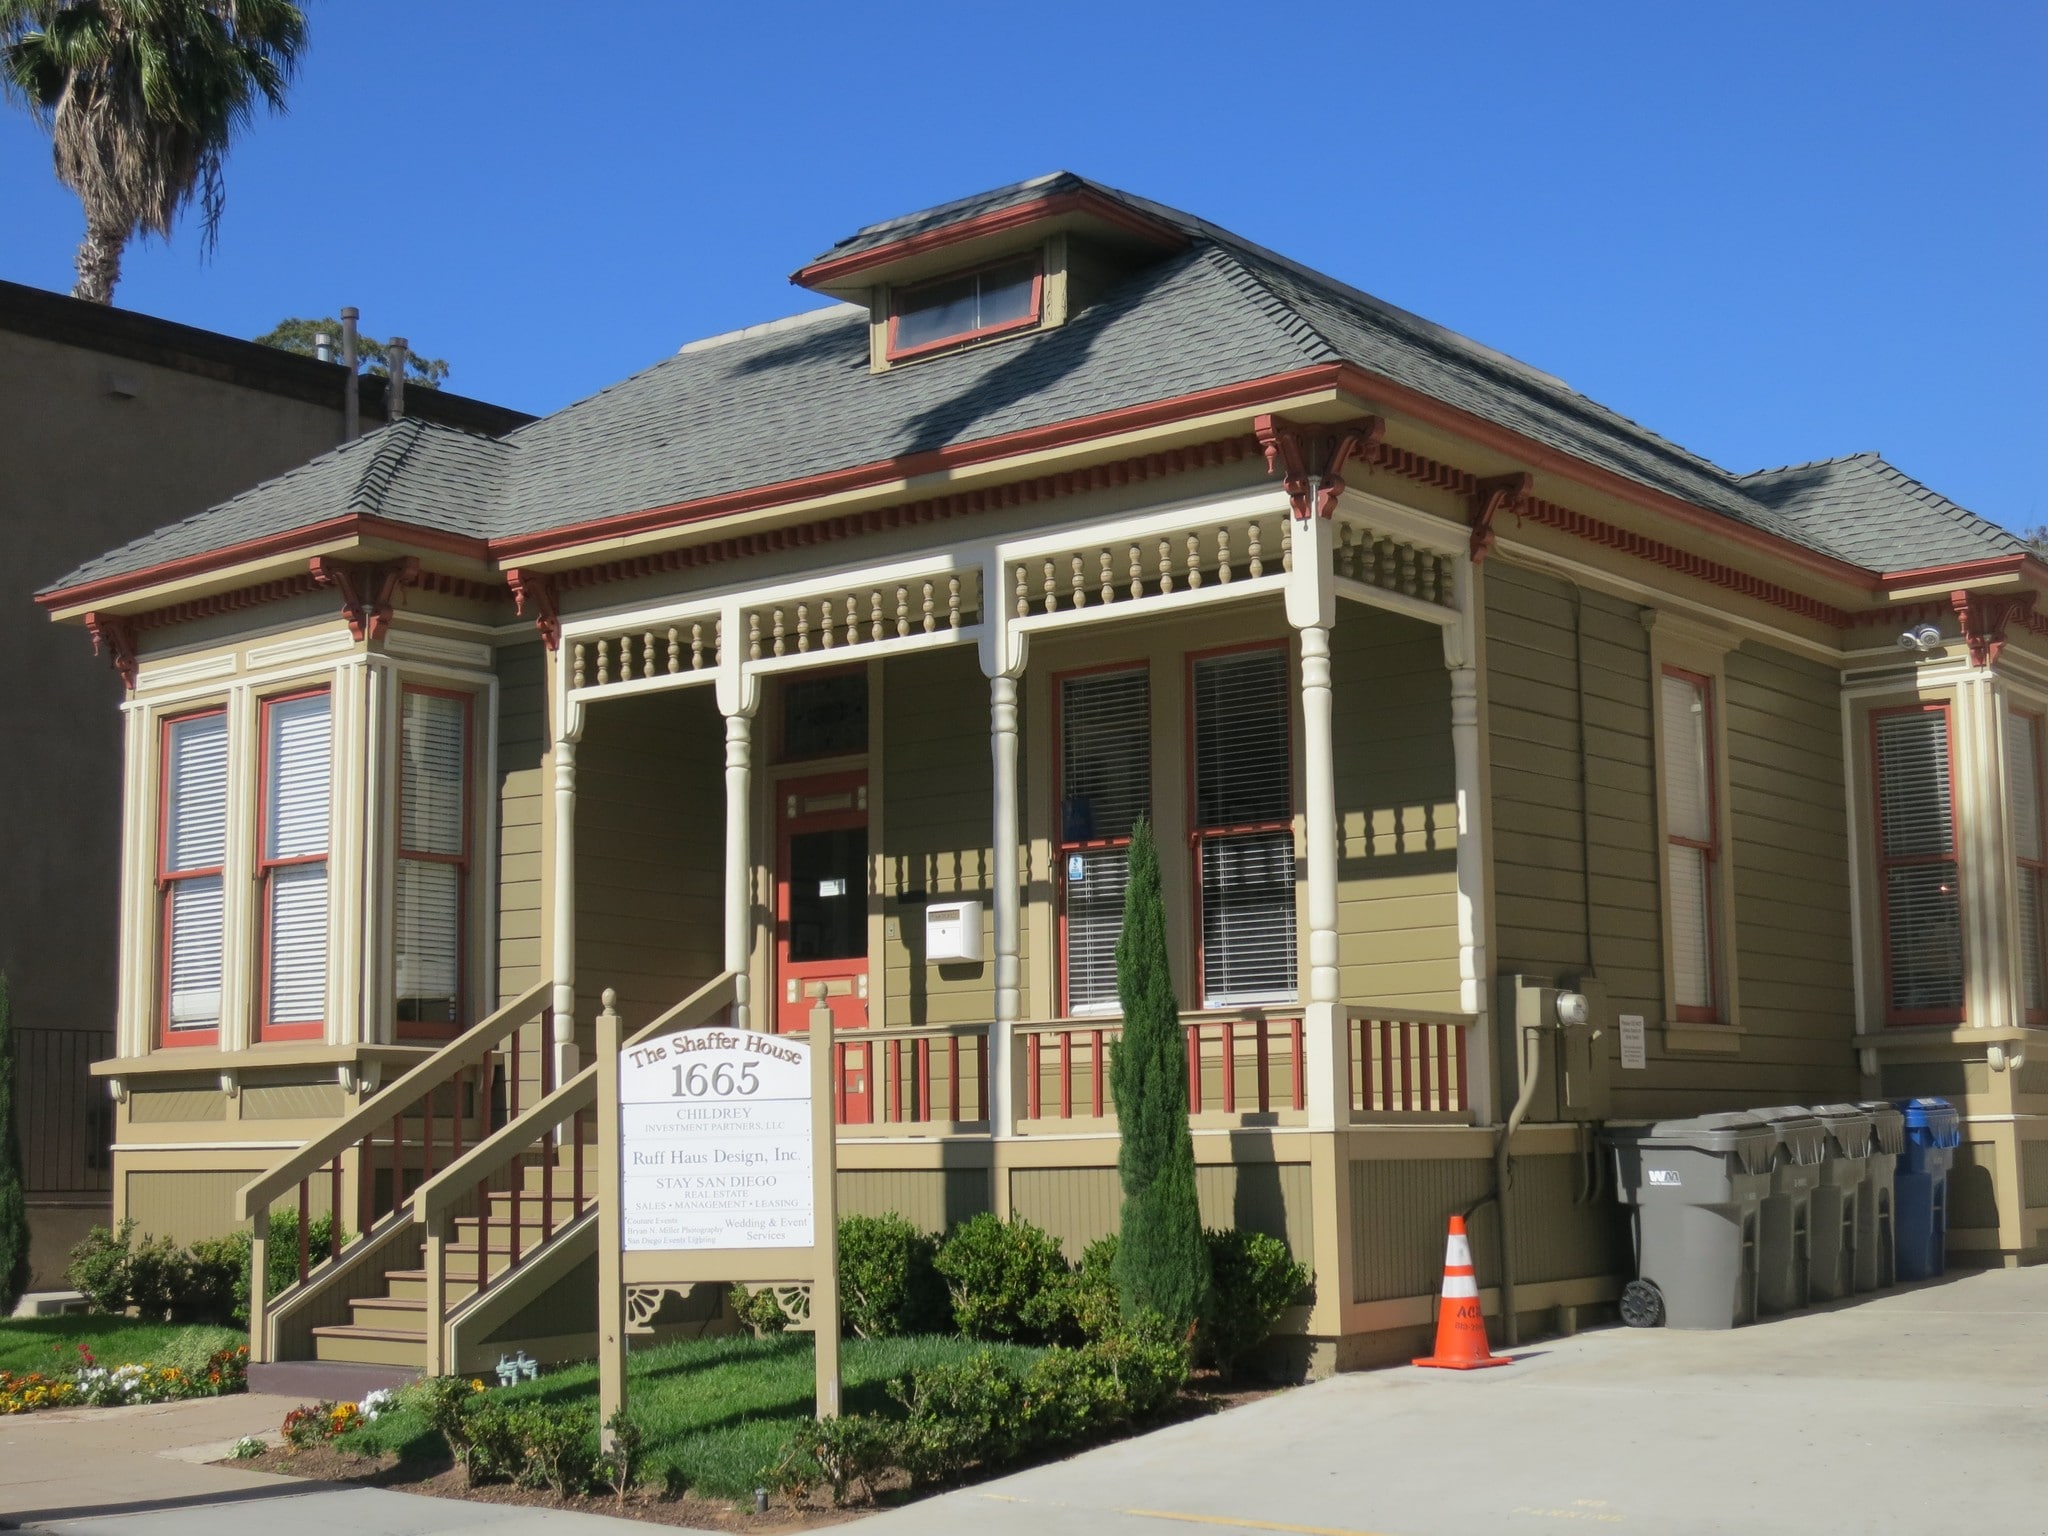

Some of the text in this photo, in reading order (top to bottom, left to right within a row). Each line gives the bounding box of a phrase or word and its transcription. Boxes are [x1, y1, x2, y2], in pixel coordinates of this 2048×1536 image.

[629, 1032, 802, 1069] The Shaffer House
[672, 1060, 760, 1097] 1665
[676, 1107, 752, 1120] CHILDREY
[645, 1123, 710, 1132] INVESTMENT
[766, 1121, 785, 1130] LLC
[633, 1147, 801, 1167] Ruff Haus Design, Inc.
[656, 1175, 777, 1189] STAY SAN DIEGO
[684, 1189, 749, 1199] REAL ESTATE
[635, 1199, 799, 1210] SALES MANAGEMENT LEASING
[725, 1217, 808, 1229] Wedding & Event
[746, 1231, 786, 1240] Services
